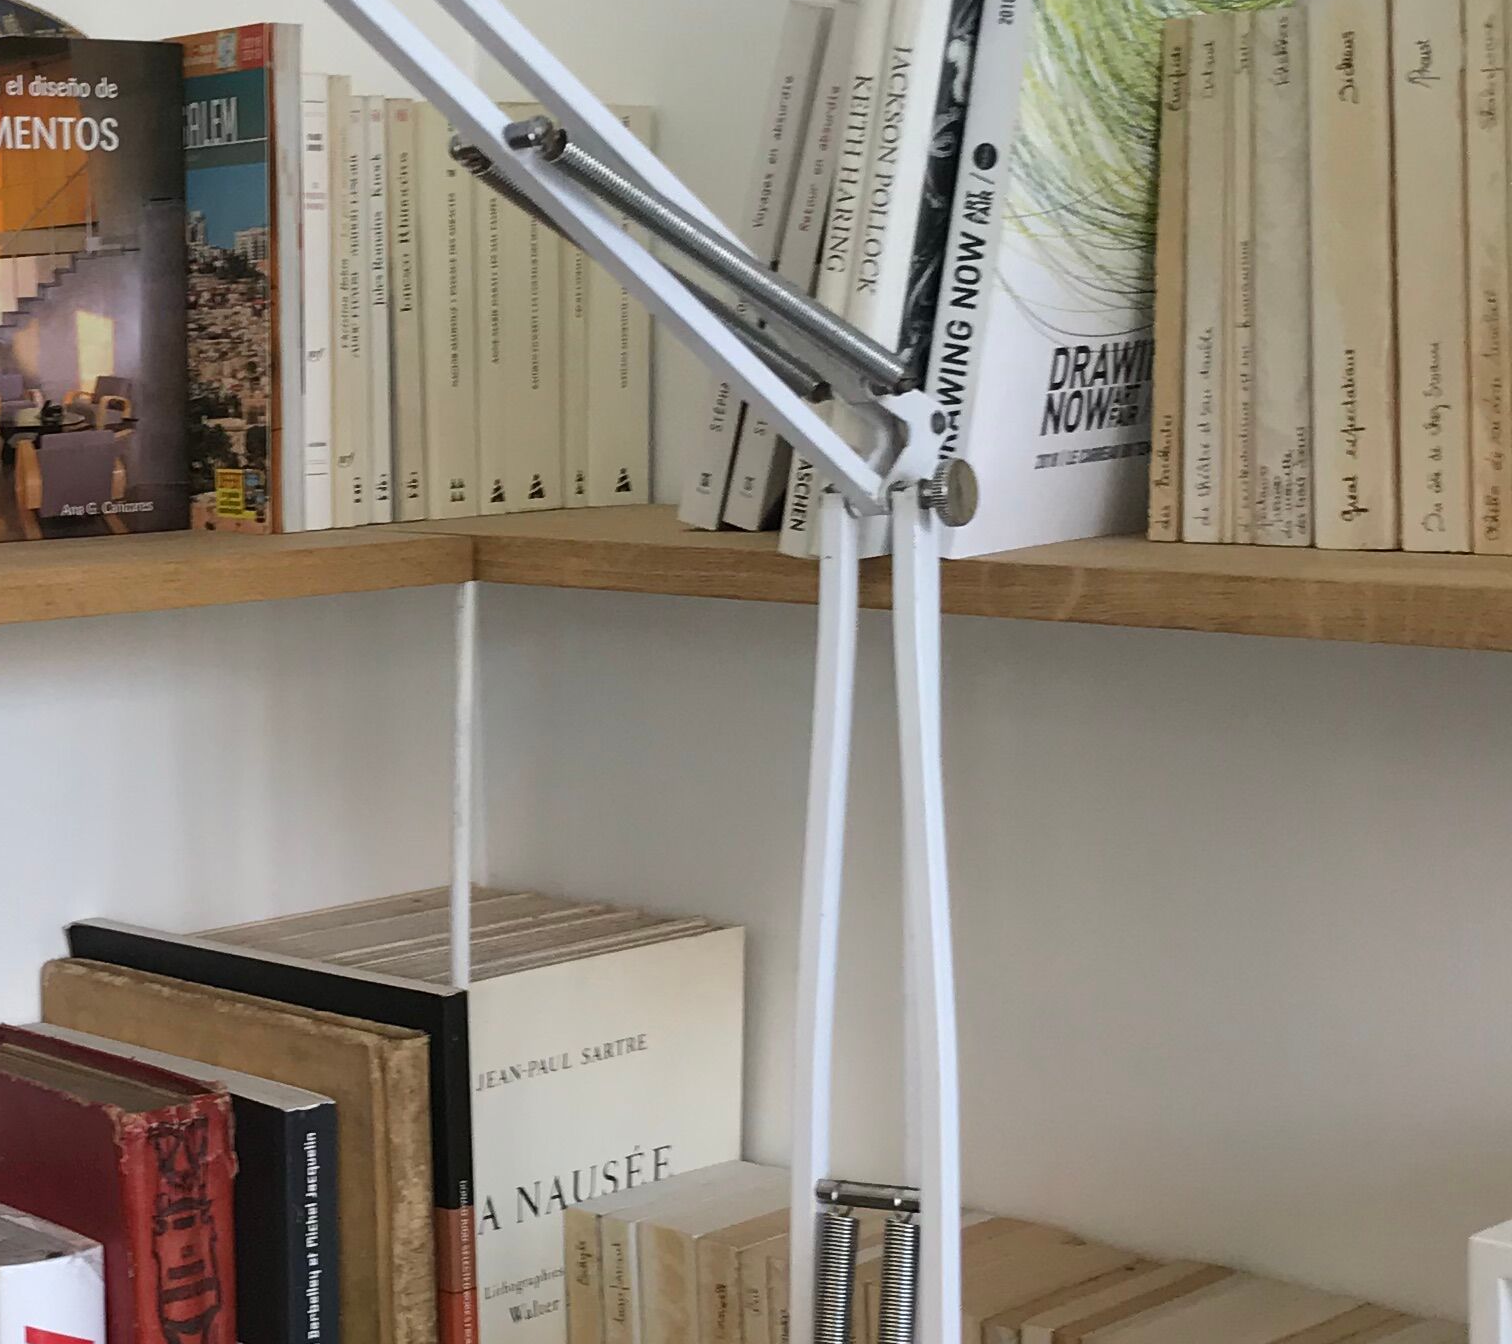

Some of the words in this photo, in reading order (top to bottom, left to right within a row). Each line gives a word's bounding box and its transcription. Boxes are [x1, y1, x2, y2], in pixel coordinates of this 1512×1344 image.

[5, 74, 24, 89] el
[28, 74, 91, 98] diseño
[94, 76, 119, 99] de
[878, 46, 913, 165] JACKSON
[183, 97, 238, 147] ALEM
[842, 74, 874, 157] KEITH
[369, 153, 383, 197] Knock
[751, 173, 775, 230] Voyages
[768, 148, 779, 164] en
[812, 159, 824, 175] en
[825, 166, 860, 273] HARING
[855, 173, 893, 296] POLLOCK
[371, 274, 386, 305] Jules
[949, 231, 987, 310] NOW
[937, 319, 973, 459] RAWING
[1050, 340, 1155, 392] DRAWI
[709, 382, 729, 432] STÉPHA
[1040, 387, 1113, 435] NOW
[60, 504, 85, 516] Ana
[788, 458, 813, 531] ASCHEN
[475, 1052, 573, 1092] JEAN-PAUL
[580, 1033, 649, 1066] SARTRE
[303, 1131, 322, 1198] Jacquelin
[477, 1194, 502, 1236] A
[515, 1144, 674, 1224] NAUSÉE
[305, 1201, 320, 1248] Michel
[307, 1252, 319, 1266] et
